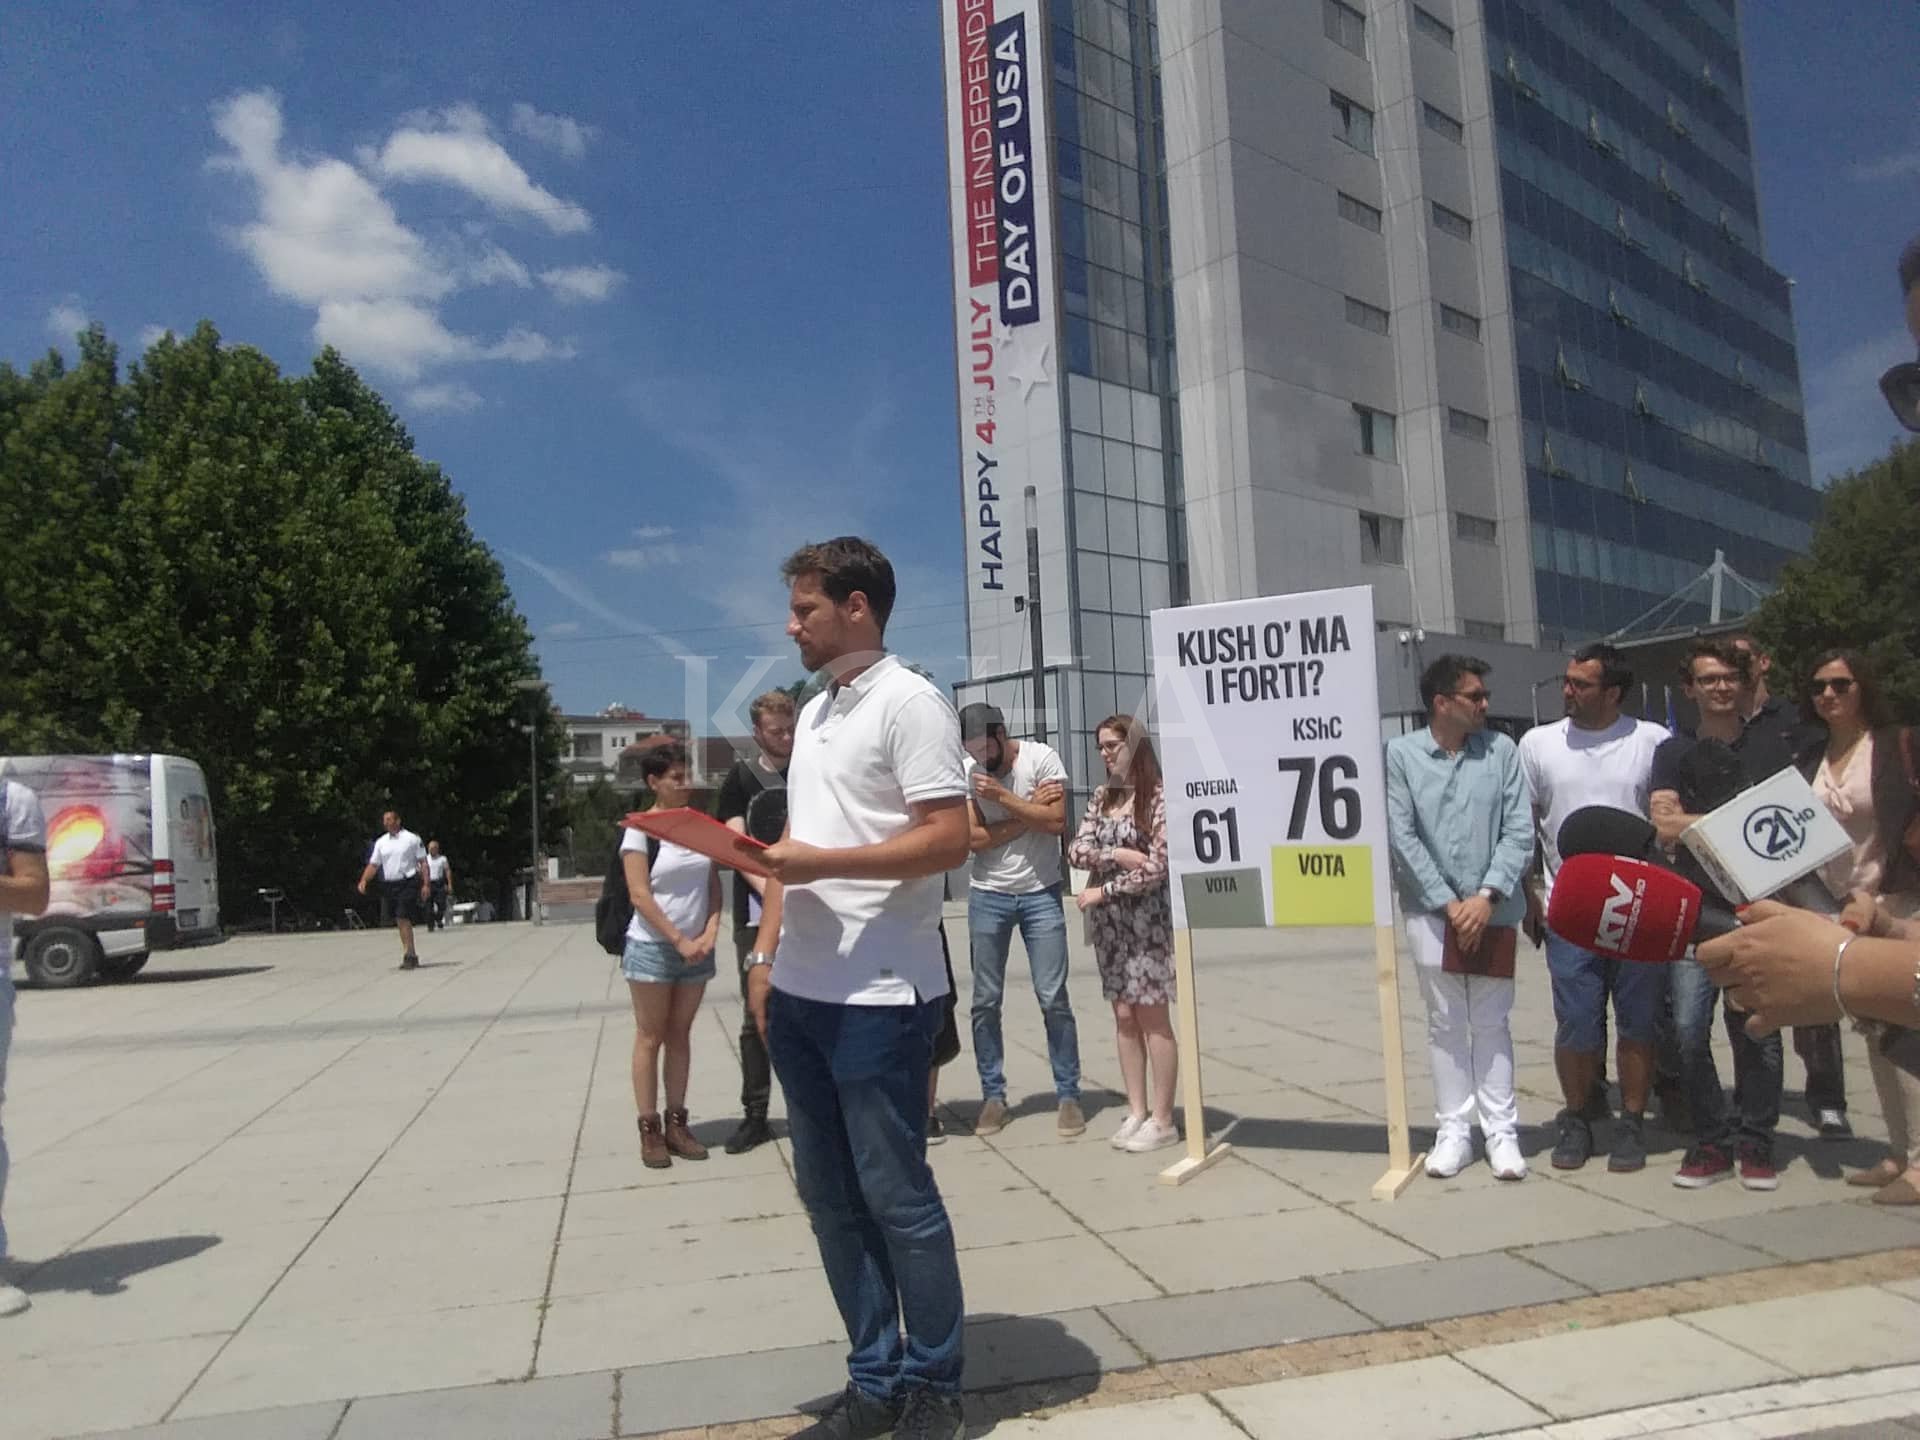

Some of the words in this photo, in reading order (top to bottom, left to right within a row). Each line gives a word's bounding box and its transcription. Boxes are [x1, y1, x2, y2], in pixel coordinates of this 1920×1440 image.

[995, 30, 1023, 129] USA
[1000, 144, 1026, 204] OF
[972, 198, 997, 272] THE
[1003, 219, 1033, 310] DAY
[970, 298, 995, 391] JULY
[975, 422, 997, 445] 4
[976, 451, 1004, 590] HAPPY
[1177, 624, 1257, 667] KUSH
[1300, 614, 1351, 654] MA
[1205, 670, 1215, 704] I
[1221, 660, 1325, 704] FORTI?
[1293, 716, 1342, 741] KShC
[1186, 778, 1238, 799] QEVERIA
[1278, 755, 1362, 841] 76
[1192, 807, 1241, 864] 61
[1754, 809, 1799, 855] 21
[1793, 808, 1815, 826] HD
[1205, 876, 1237, 894] VOTA
[1298, 853, 1345, 877] VOTA
[1593, 872, 1634, 951] KTV
